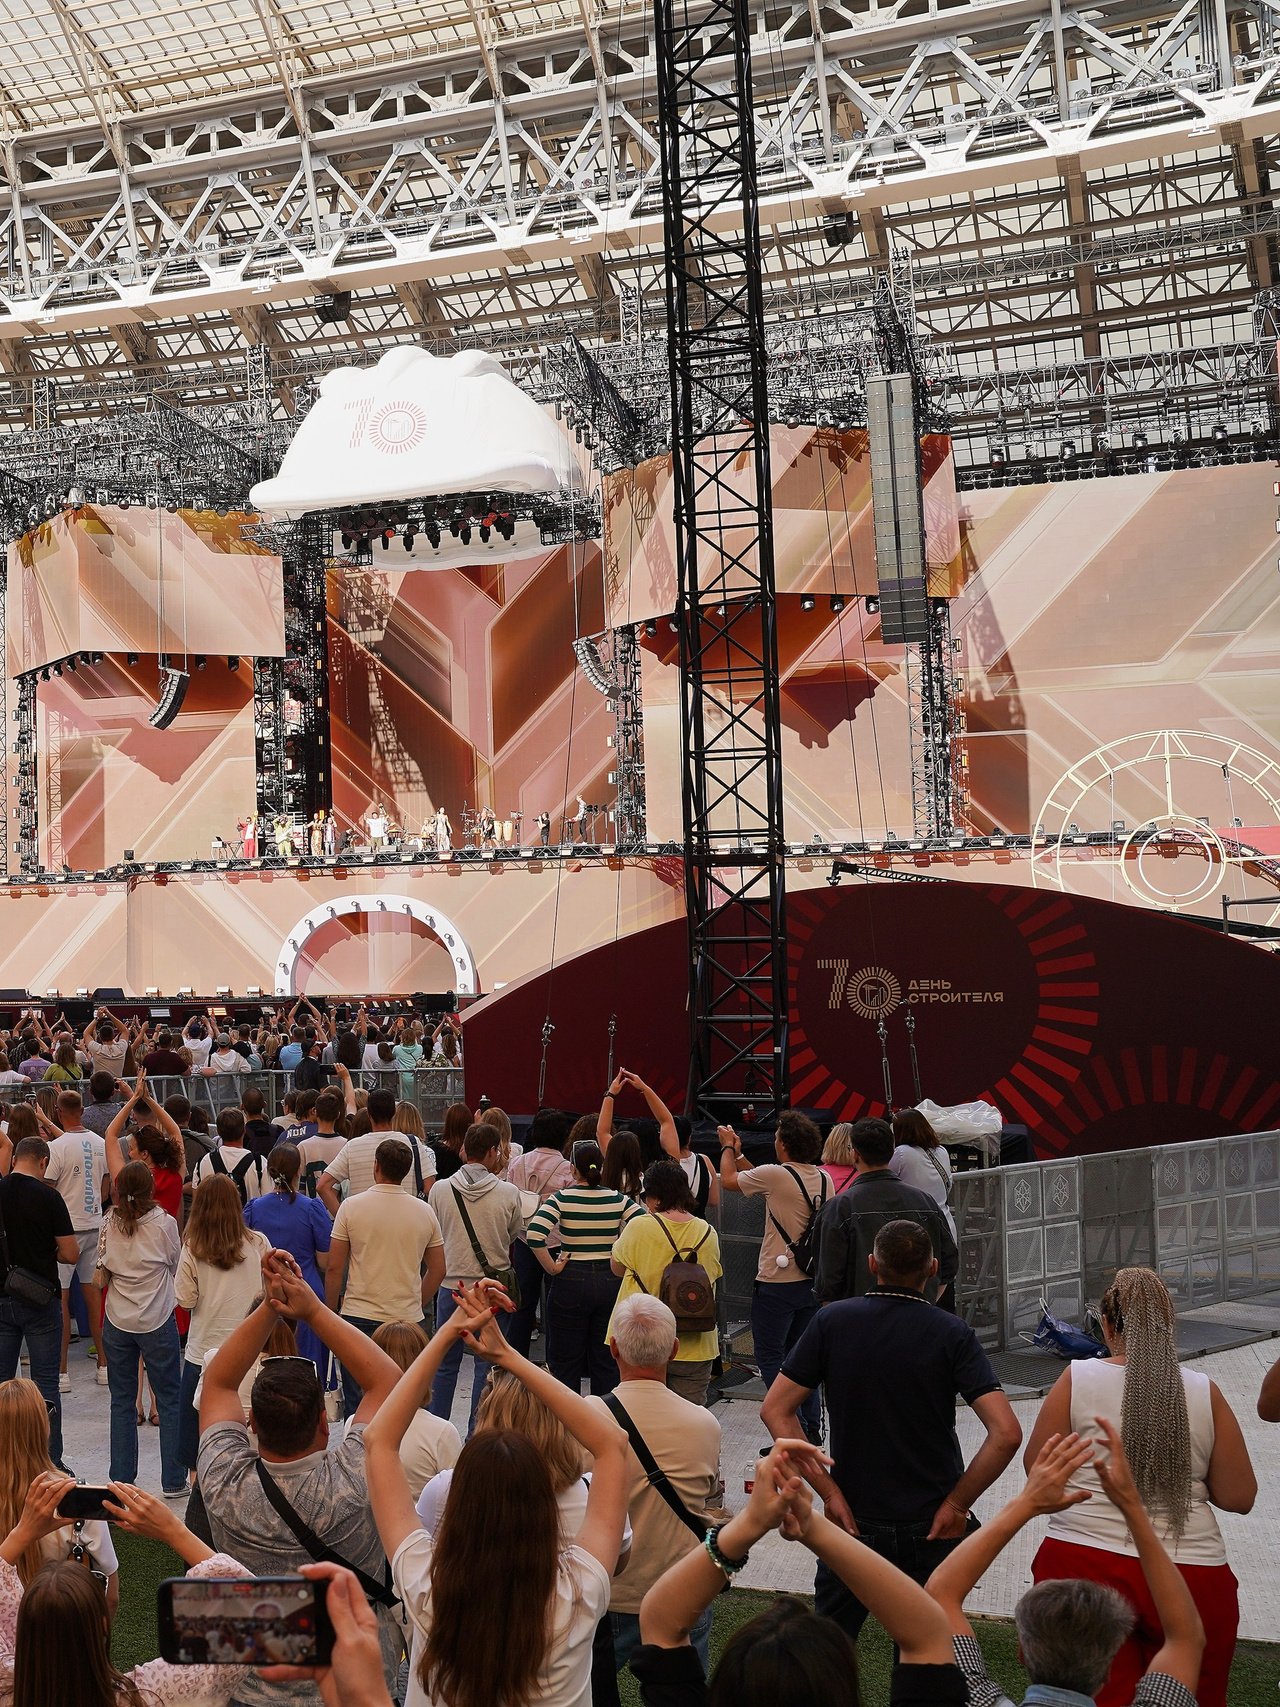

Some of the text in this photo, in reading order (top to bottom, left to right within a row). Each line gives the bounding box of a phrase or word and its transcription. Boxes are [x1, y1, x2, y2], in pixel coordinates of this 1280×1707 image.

[908, 980, 952, 990] ДЕНЬ
[908, 992, 1004, 1004] СТРОИТЕЛЯ
[82, 1140, 95, 1214] AQUAPOLIS
